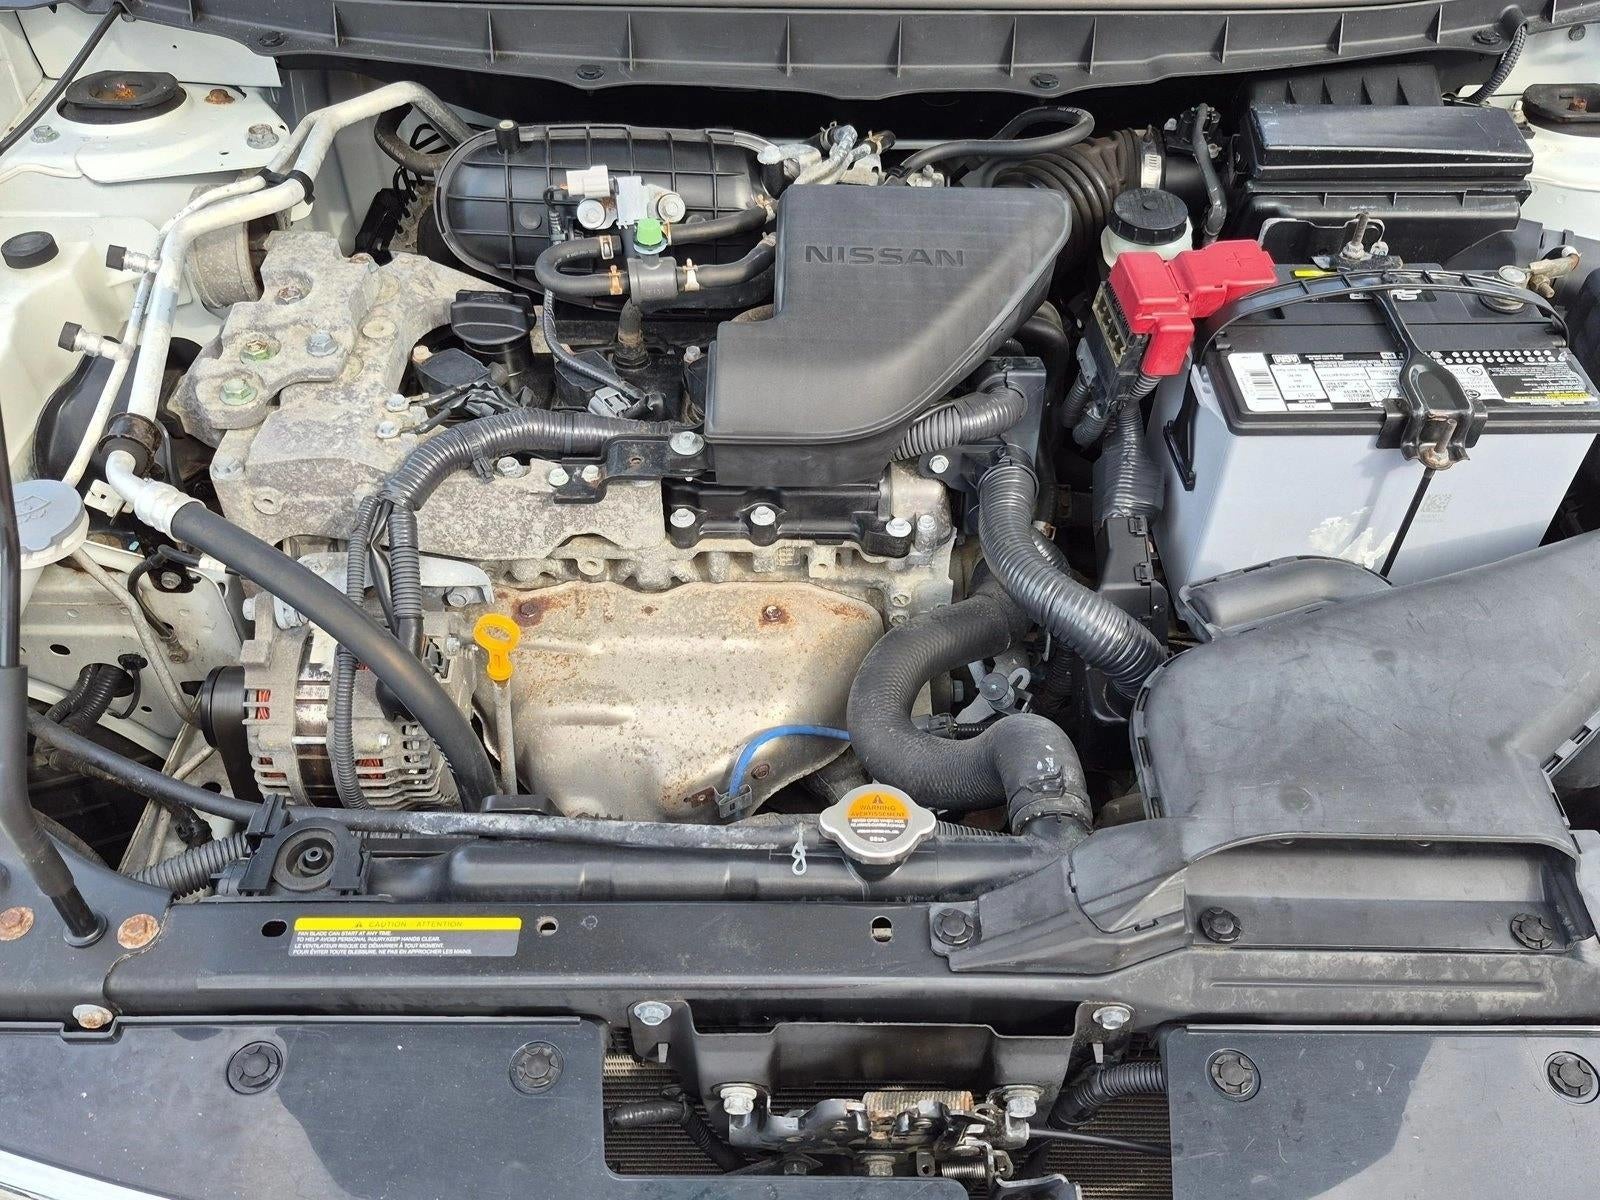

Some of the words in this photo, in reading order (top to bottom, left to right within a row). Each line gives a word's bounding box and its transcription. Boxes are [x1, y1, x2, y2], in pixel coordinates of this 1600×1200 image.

[805, 245, 964, 266] NISSAN
[368, 920, 407, 928] CAUTION
[416, 920, 464, 928] ATTENTION
